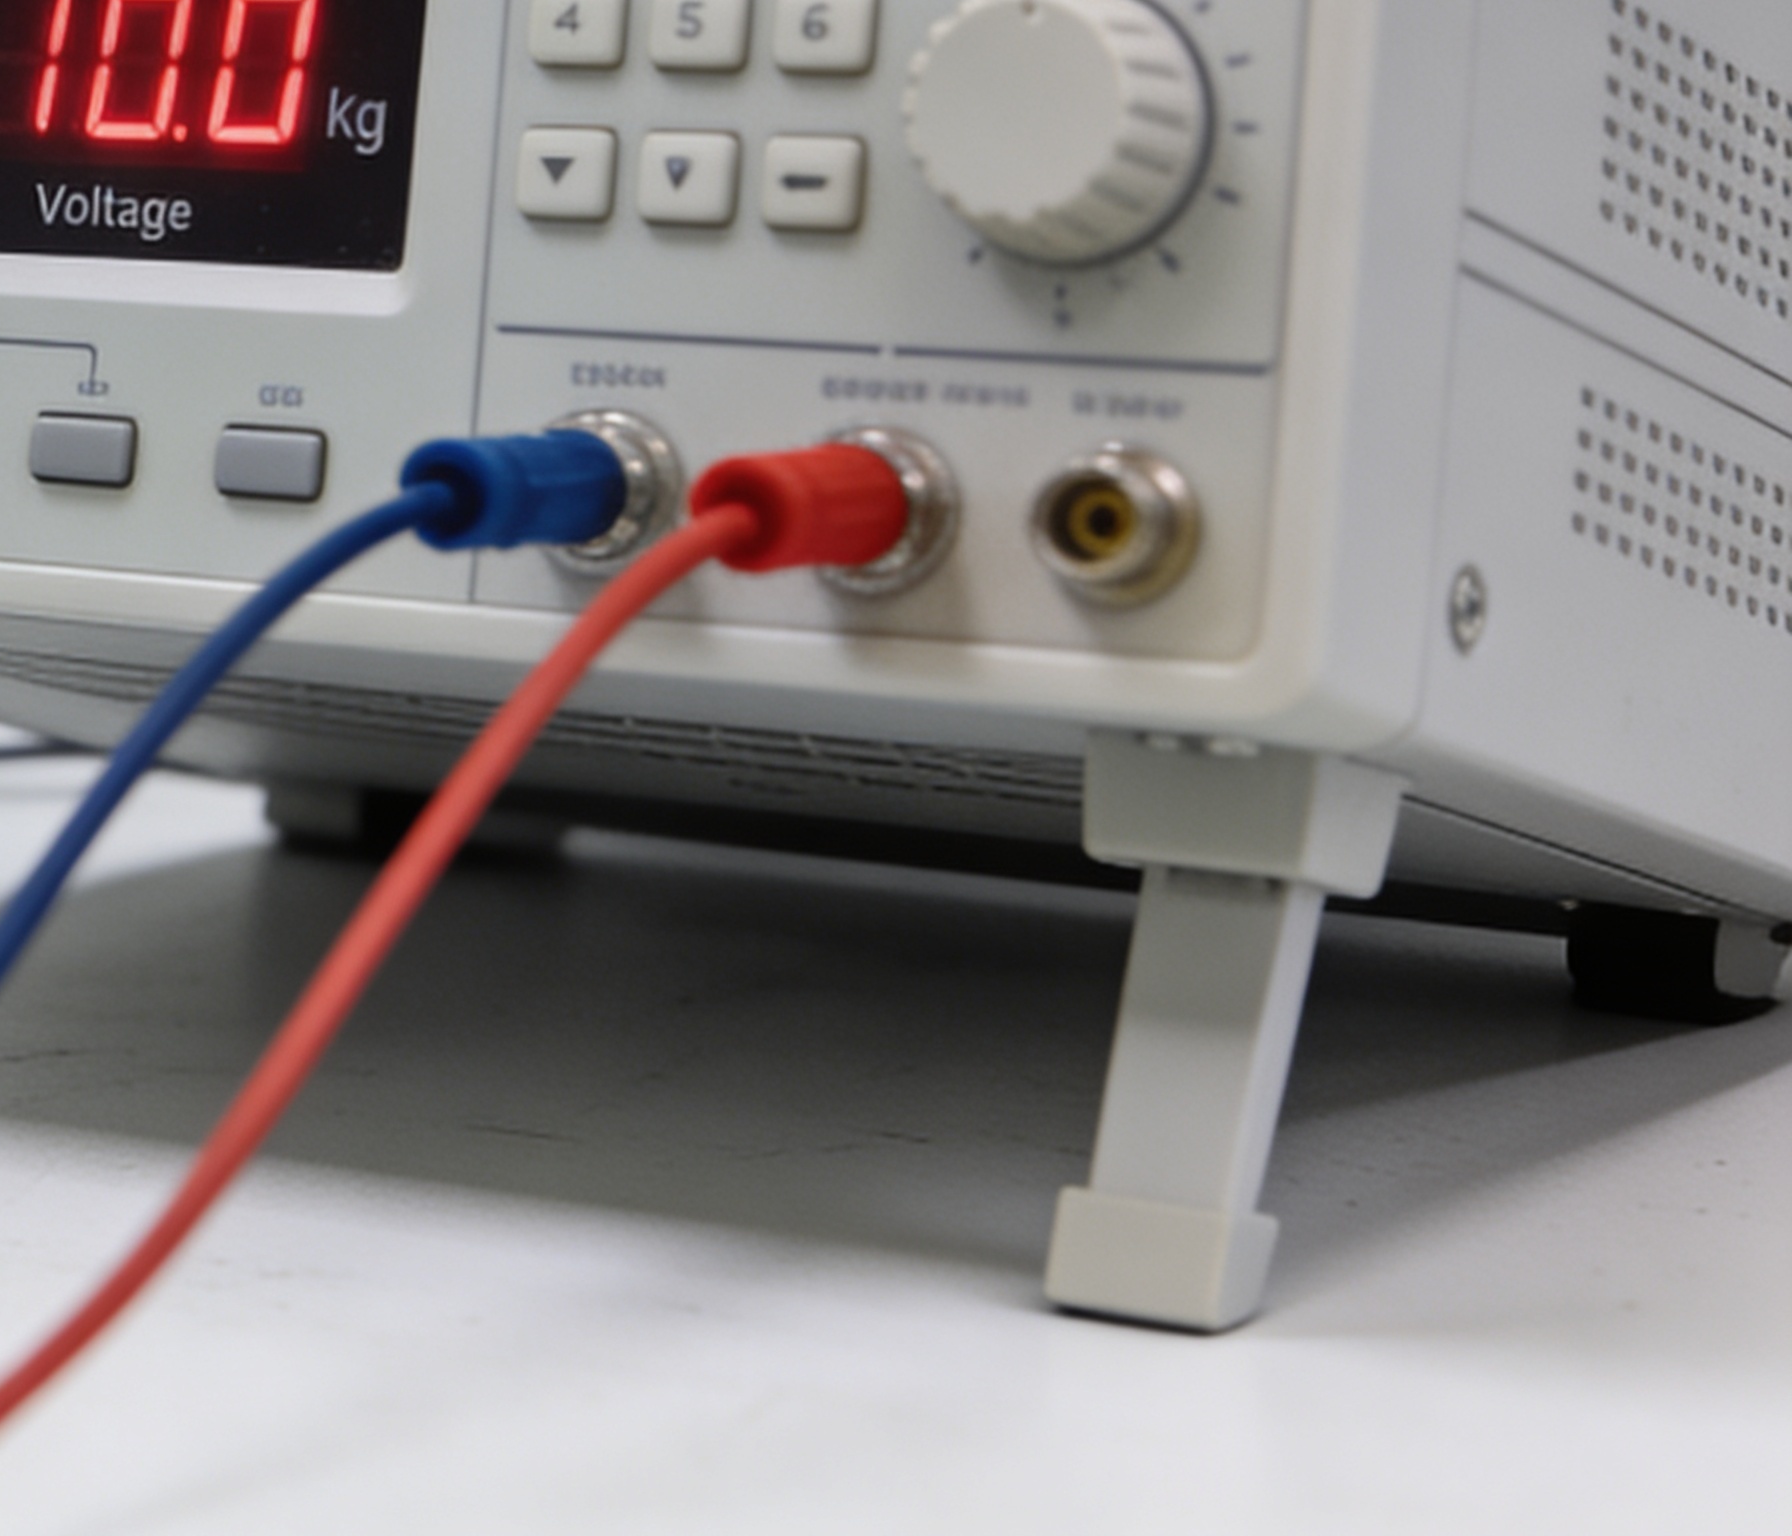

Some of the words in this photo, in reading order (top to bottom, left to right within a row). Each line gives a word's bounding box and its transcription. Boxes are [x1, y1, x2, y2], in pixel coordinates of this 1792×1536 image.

[553, 1, 581, 35] 4
[674, 0, 705, 40] 5
[800, 2, 830, 41] 6
[326, 86, 388, 156] kg
[35, 183, 193, 242] Voltage
